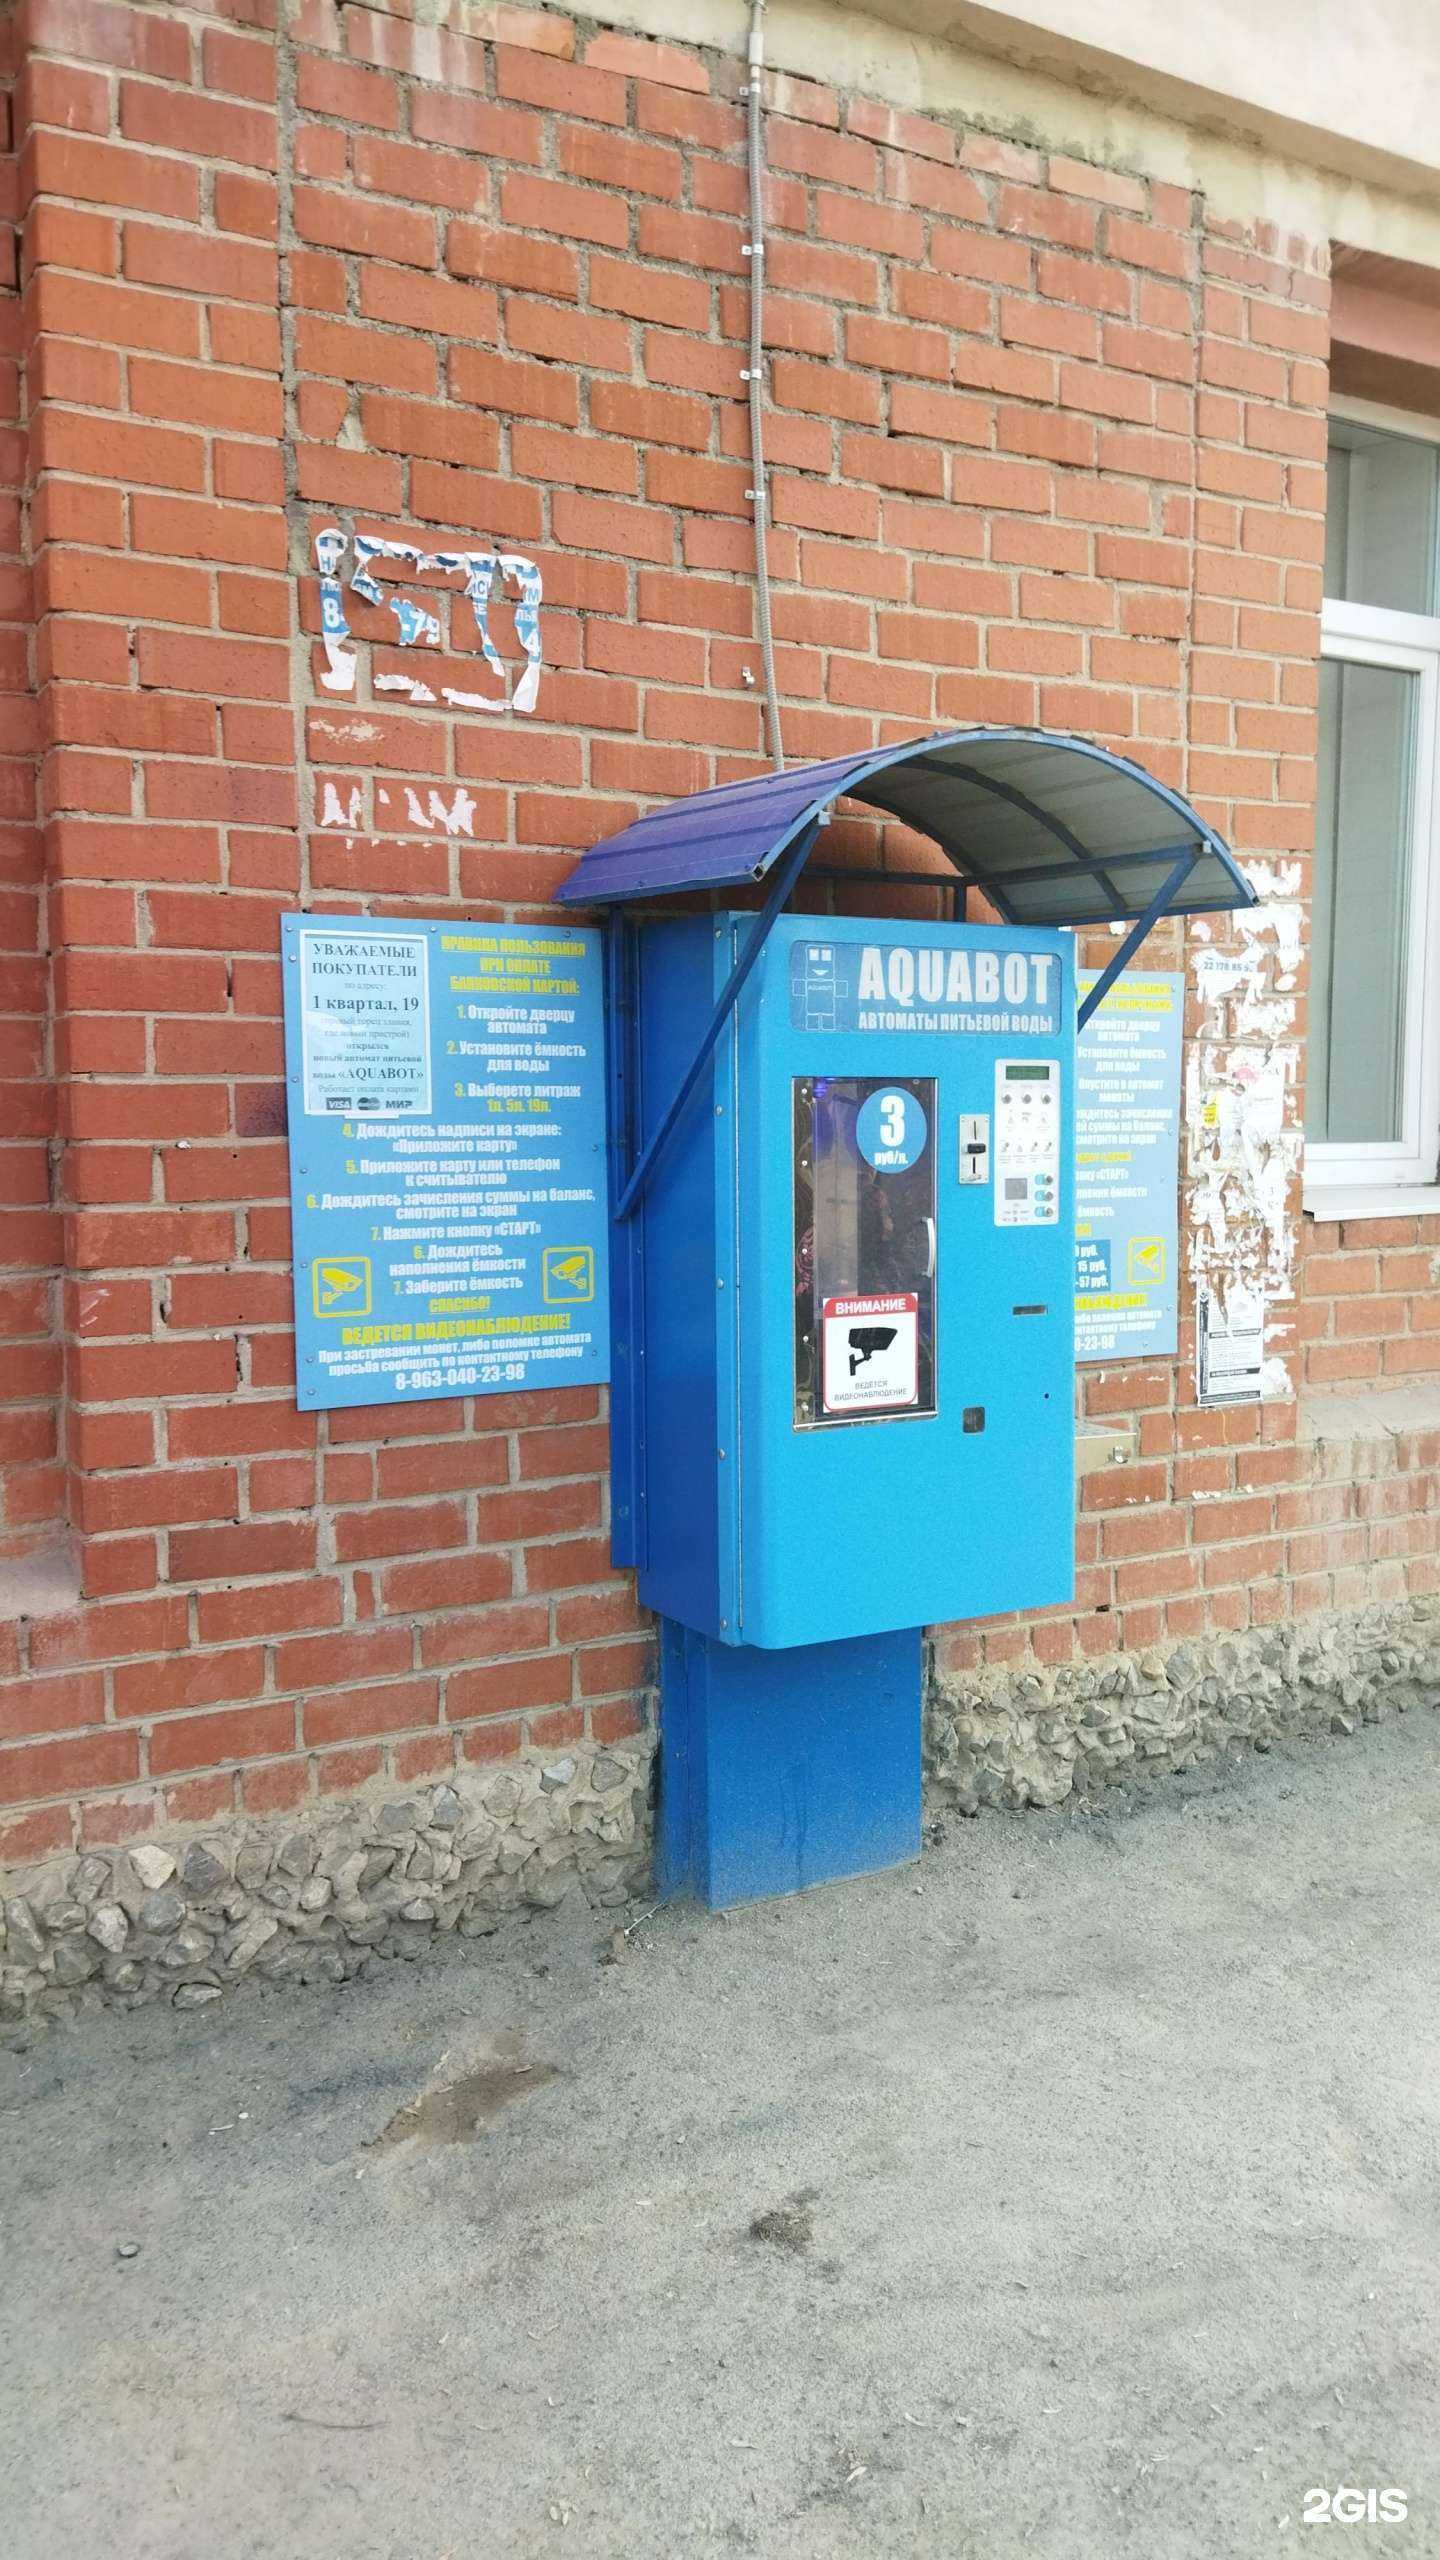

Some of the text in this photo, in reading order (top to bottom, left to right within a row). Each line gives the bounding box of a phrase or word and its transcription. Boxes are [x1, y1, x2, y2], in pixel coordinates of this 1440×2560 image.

[313, 943, 416, 958] УВАЖАЕМЫЕ
[441, 935, 586, 957] ПРАВИЛА ПОЛЬЗОВАНИЯ
[312, 962, 417, 977] ПОКУПАТЕЛИ
[480, 957, 504, 973] ПРИ
[451, 975, 531, 992] БАНКОВСКОЙ
[858, 947, 1053, 1006] AQUABOT
[313, 995, 320, 1009] 1
[402, 997, 420, 1012] 19
[468, 1004, 528, 1021] Откройте
[530, 1008, 576, 1024] дверцу
[858, 1011, 1053, 1034] АВТОМАТЫ ПИТЬЕВОЙ ВОДЫ
[487, 1022, 548, 1034] автомата
[346, 1044, 389, 1052] открылся
[459, 1041, 533, 1056] Установите
[534, 1041, 587, 1057] ёмкость
[487, 1059, 550, 1074] для воды
[534, 1084, 581, 1098] литраж
[385, 1101, 413, 1109] МИР
[880, 1095, 906, 1147] 3
[357, 1123, 436, 1139] Дождитесь
[438, 1124, 494, 1138] надписи
[497, 1124, 513, 1136] на
[515, 1124, 562, 1136] экране:
[360, 1159, 438, 1175] Приложите
[440, 1160, 477, 1174] карту
[479, 1159, 503, 1172] или
[506, 1156, 560, 1171] телефон
[873, 1150, 909, 1167] руб/л.
[405, 1173, 507, 1187] к считывателю
[321, 1193, 402, 1210] Дождитесь
[404, 1192, 483, 1206] зачисления
[485, 1191, 531, 1204] суммы
[532, 1190, 548, 1202] на
[550, 1188, 596, 1202] баланс,
[396, 1203, 517, 1220] смотрите на экран
[383, 1225, 445, 1241] Нажмите
[447, 1224, 493, 1239] кнопку
[494, 1221, 541, 1236] «СТАРТ»
[427, 1244, 503, 1260] Дождитесь
[390, 1257, 526, 1276] наполнения ёмкости
[405, 1279, 468, 1295] Заберите
[470, 1277, 523, 1292] ёмкость
[835, 1299, 906, 1315] ВНИМАНИЕ
[319, 1350, 342, 1364] При
[344, 1346, 422, 1362] застревании
[462, 1340, 490, 1353] либо
[492, 1336, 539, 1351] поломке
[541, 1333, 591, 1346] автомата
[329, 1346, 583, 1376] просьба сообщить по контактному телефону
[396, 1363, 525, 1390] 8-963-040-23-98
[855, 1380, 888, 1390] ВЕДЕТСЯ
[834, 1388, 907, 1401] ВИДЕОНАБЛЮДЕНИЕ
